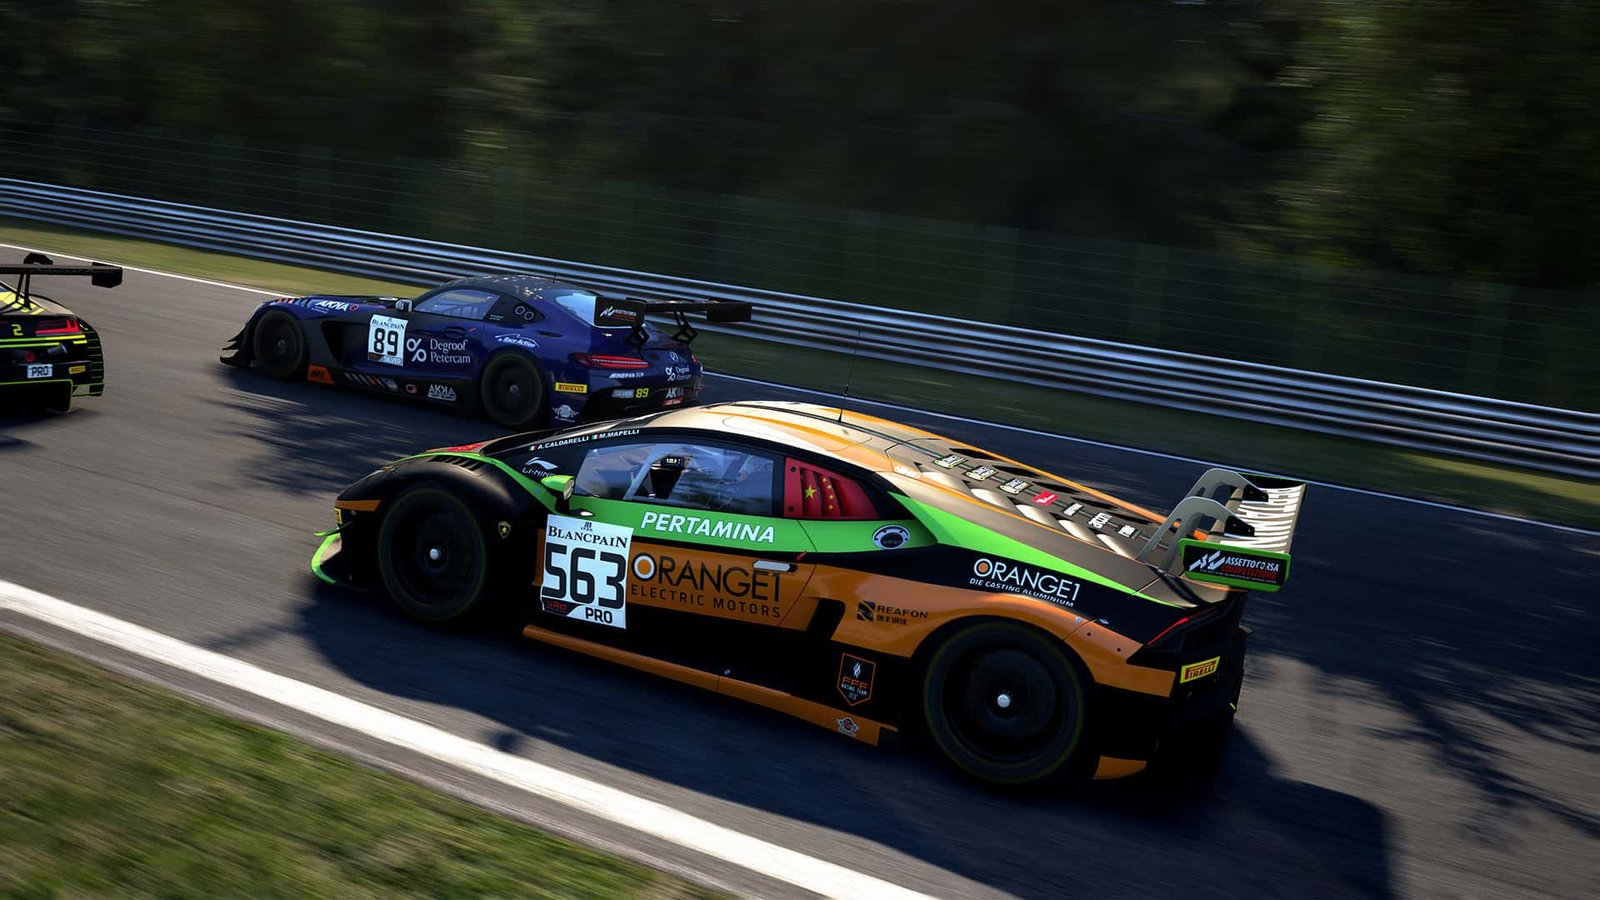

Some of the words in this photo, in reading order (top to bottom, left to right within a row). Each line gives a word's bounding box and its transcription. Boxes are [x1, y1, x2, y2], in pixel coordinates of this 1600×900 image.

[10, 323, 24, 336] 2
[374, 327, 399, 356] 89
[429, 338, 469, 353] Degroof
[430, 351, 471, 364] Petercam
[31, 365, 49, 377] PRO
[635, 387, 650, 398] 89
[599, 429, 640, 439] M.MAPELLI
[537, 436, 589, 450] A.CALDARELLI
[640, 511, 775, 543] PERTAMINA
[548, 525, 628, 548] BLANCPAIN
[541, 542, 626, 609] 563
[632, 552, 780, 602] ORANGE1
[973, 558, 1081, 601] ORANGE1
[969, 577, 983, 586] DIE
[985, 581, 1020, 593] CASTING
[1022, 588, 1075, 608] ALUMINIUM
[631, 584, 704, 606] ELECTRIC
[713, 597, 781, 618] MOTORS
[585, 608, 613, 624] PRO
[877, 605, 929, 619] REAFON
[842, 676, 869, 689] FFF
